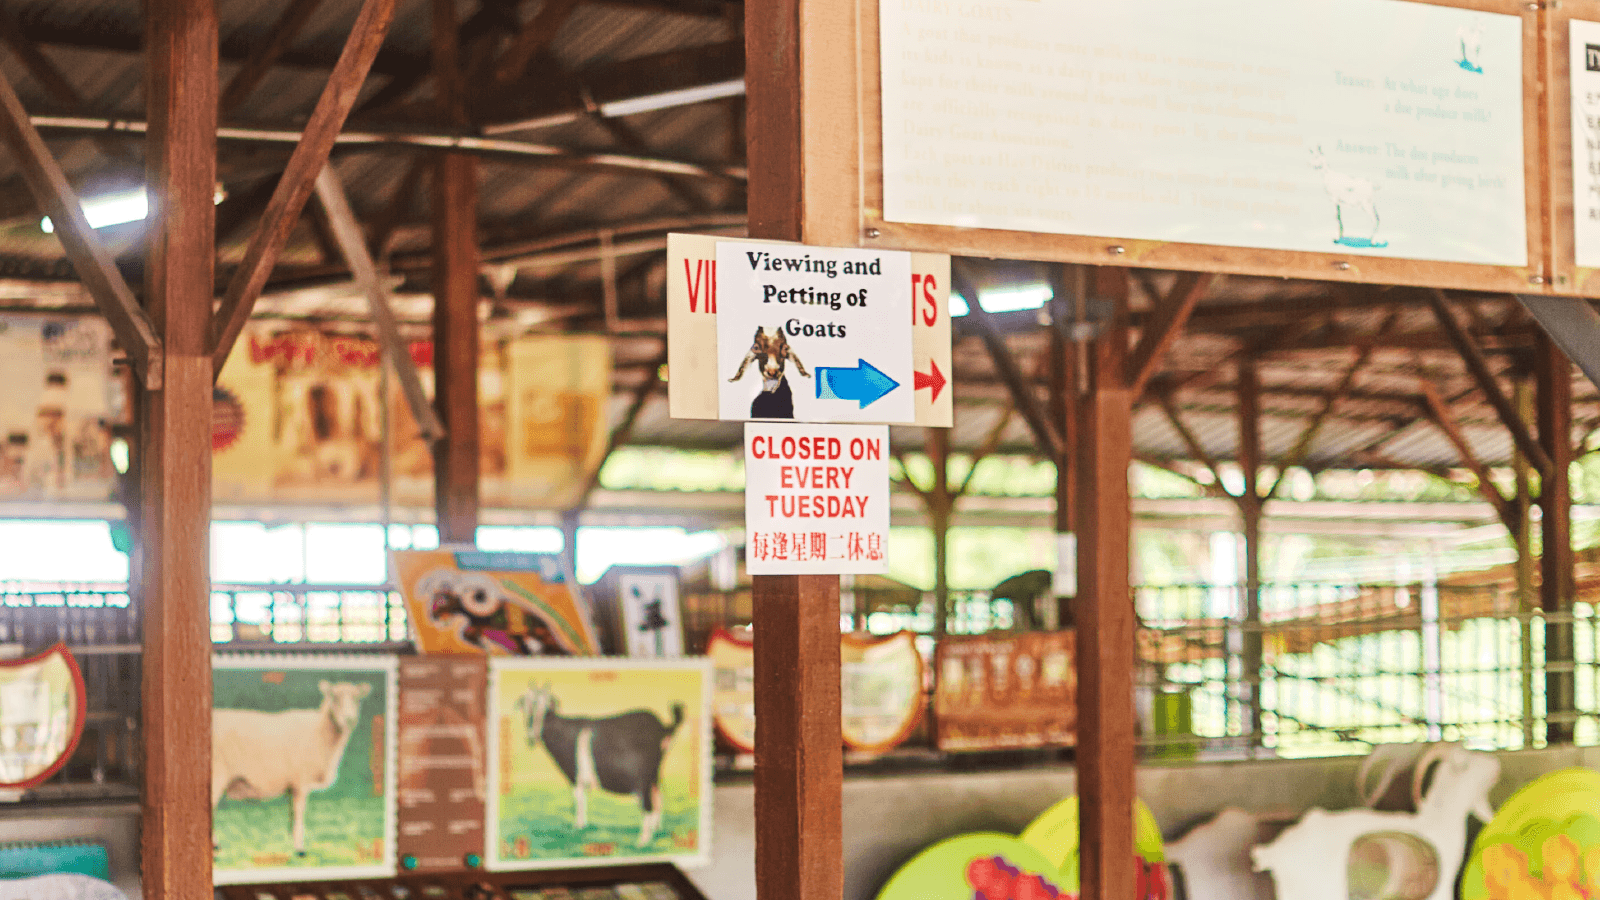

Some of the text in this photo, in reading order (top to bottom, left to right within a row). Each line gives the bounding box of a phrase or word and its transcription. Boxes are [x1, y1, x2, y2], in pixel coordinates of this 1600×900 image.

[746, 251, 882, 278] Viewing and
[762, 285, 867, 310] Petting of
[785, 318, 847, 338] Goats
[752, 436, 881, 461] CLOSED ON
[781, 466, 855, 489] EVERY
[765, 495, 869, 518] TUESDAY
[752, 531, 884, 562] 每逢星期二休息
